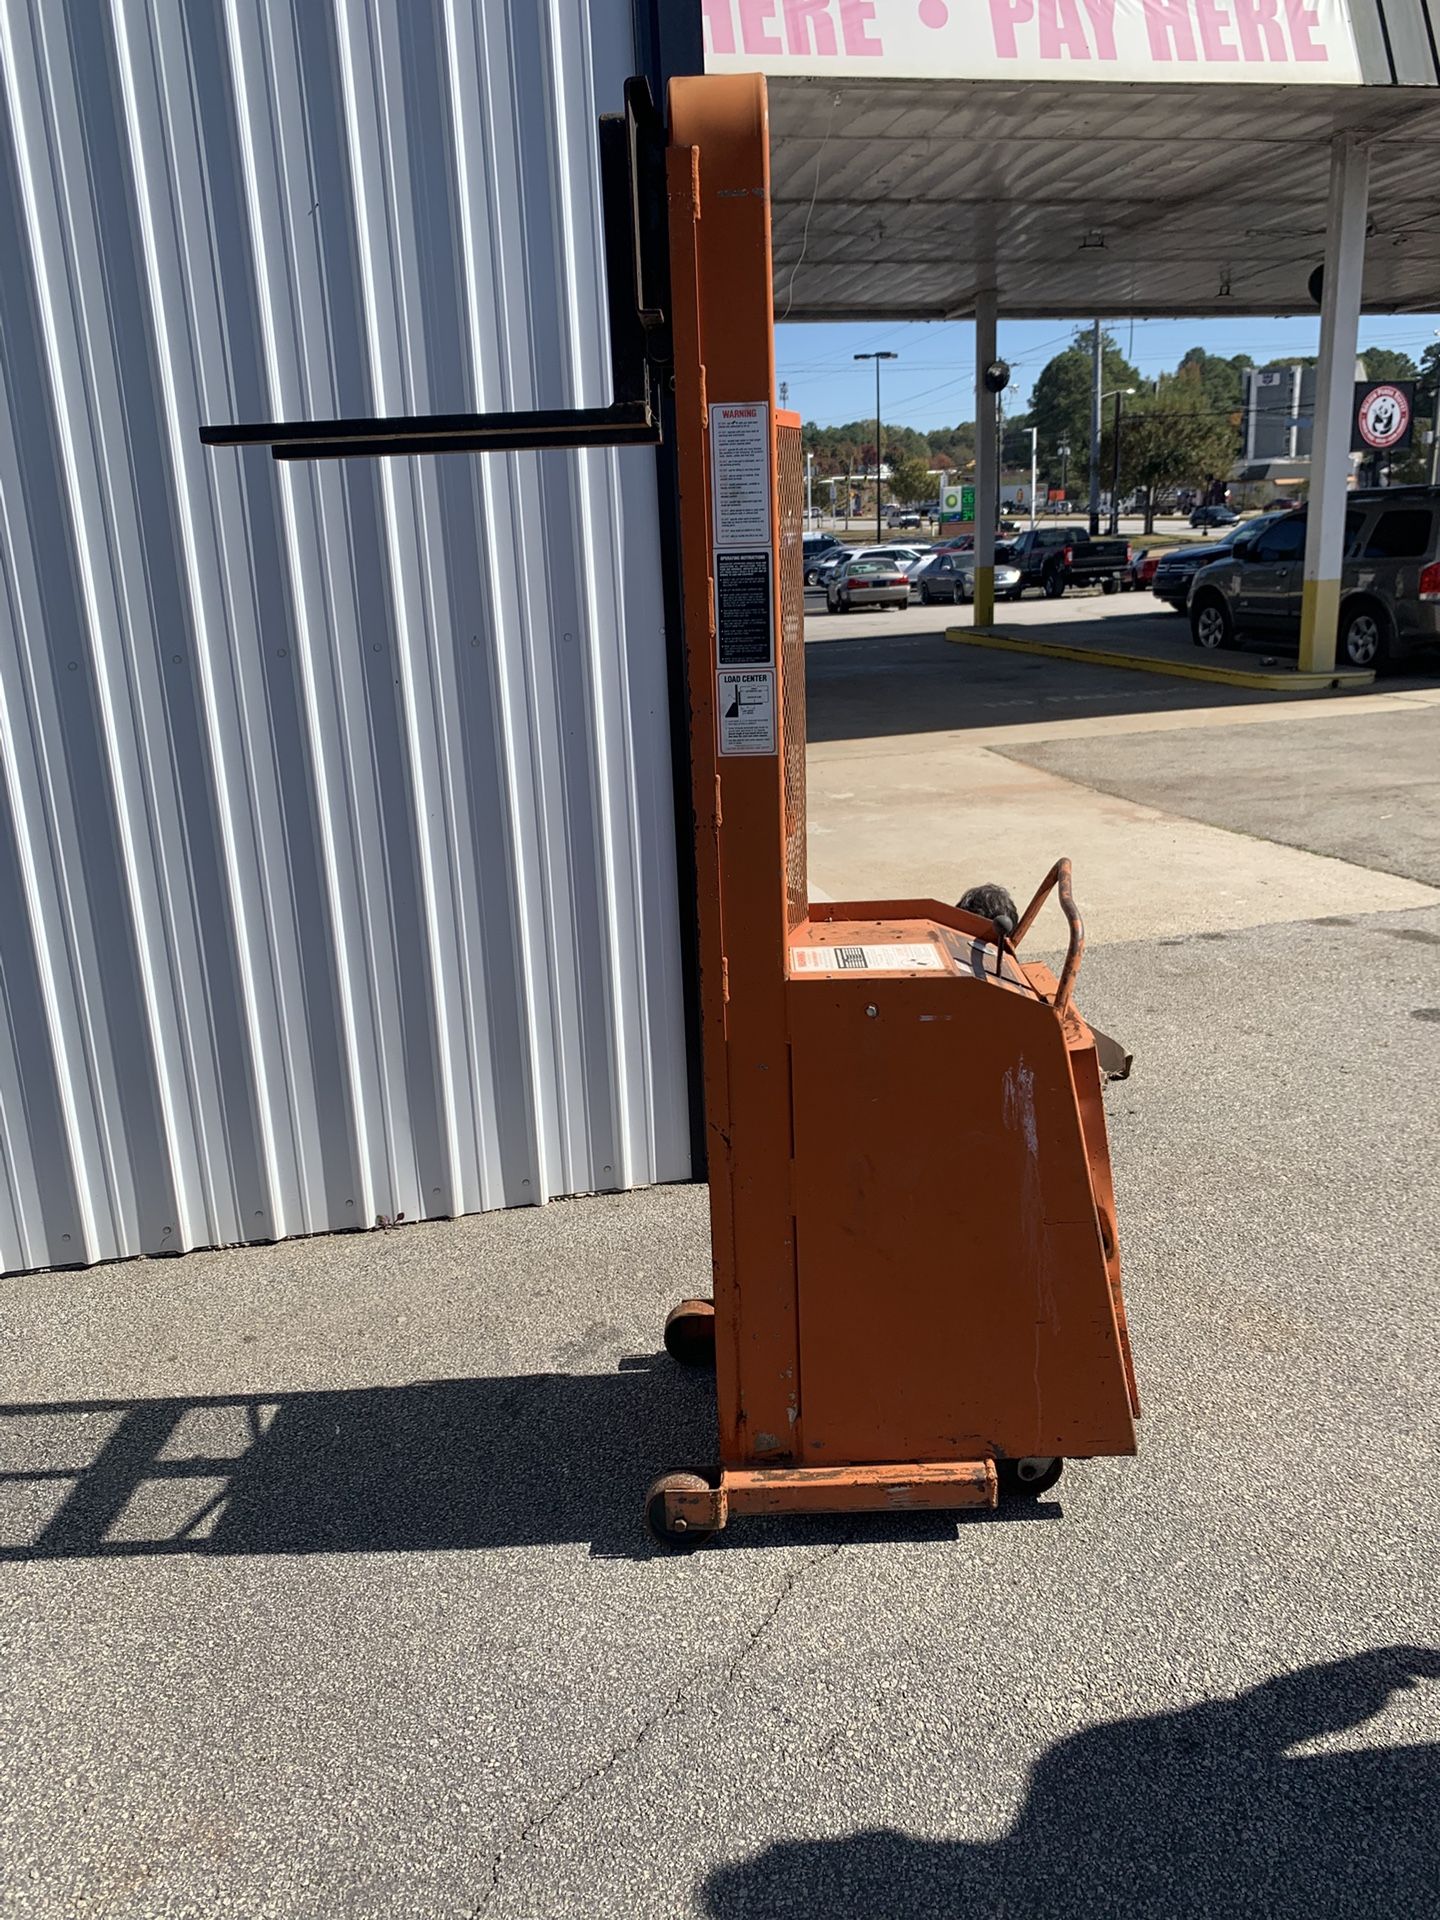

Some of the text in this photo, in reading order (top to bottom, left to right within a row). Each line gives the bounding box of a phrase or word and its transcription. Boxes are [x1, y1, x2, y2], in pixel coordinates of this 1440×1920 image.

[988, 0, 1118, 60] PAY
[1143, 0, 1329, 61] HERE
[722, 409, 757, 419] WARNING
[724, 674, 767, 683] LOAD CENTER
